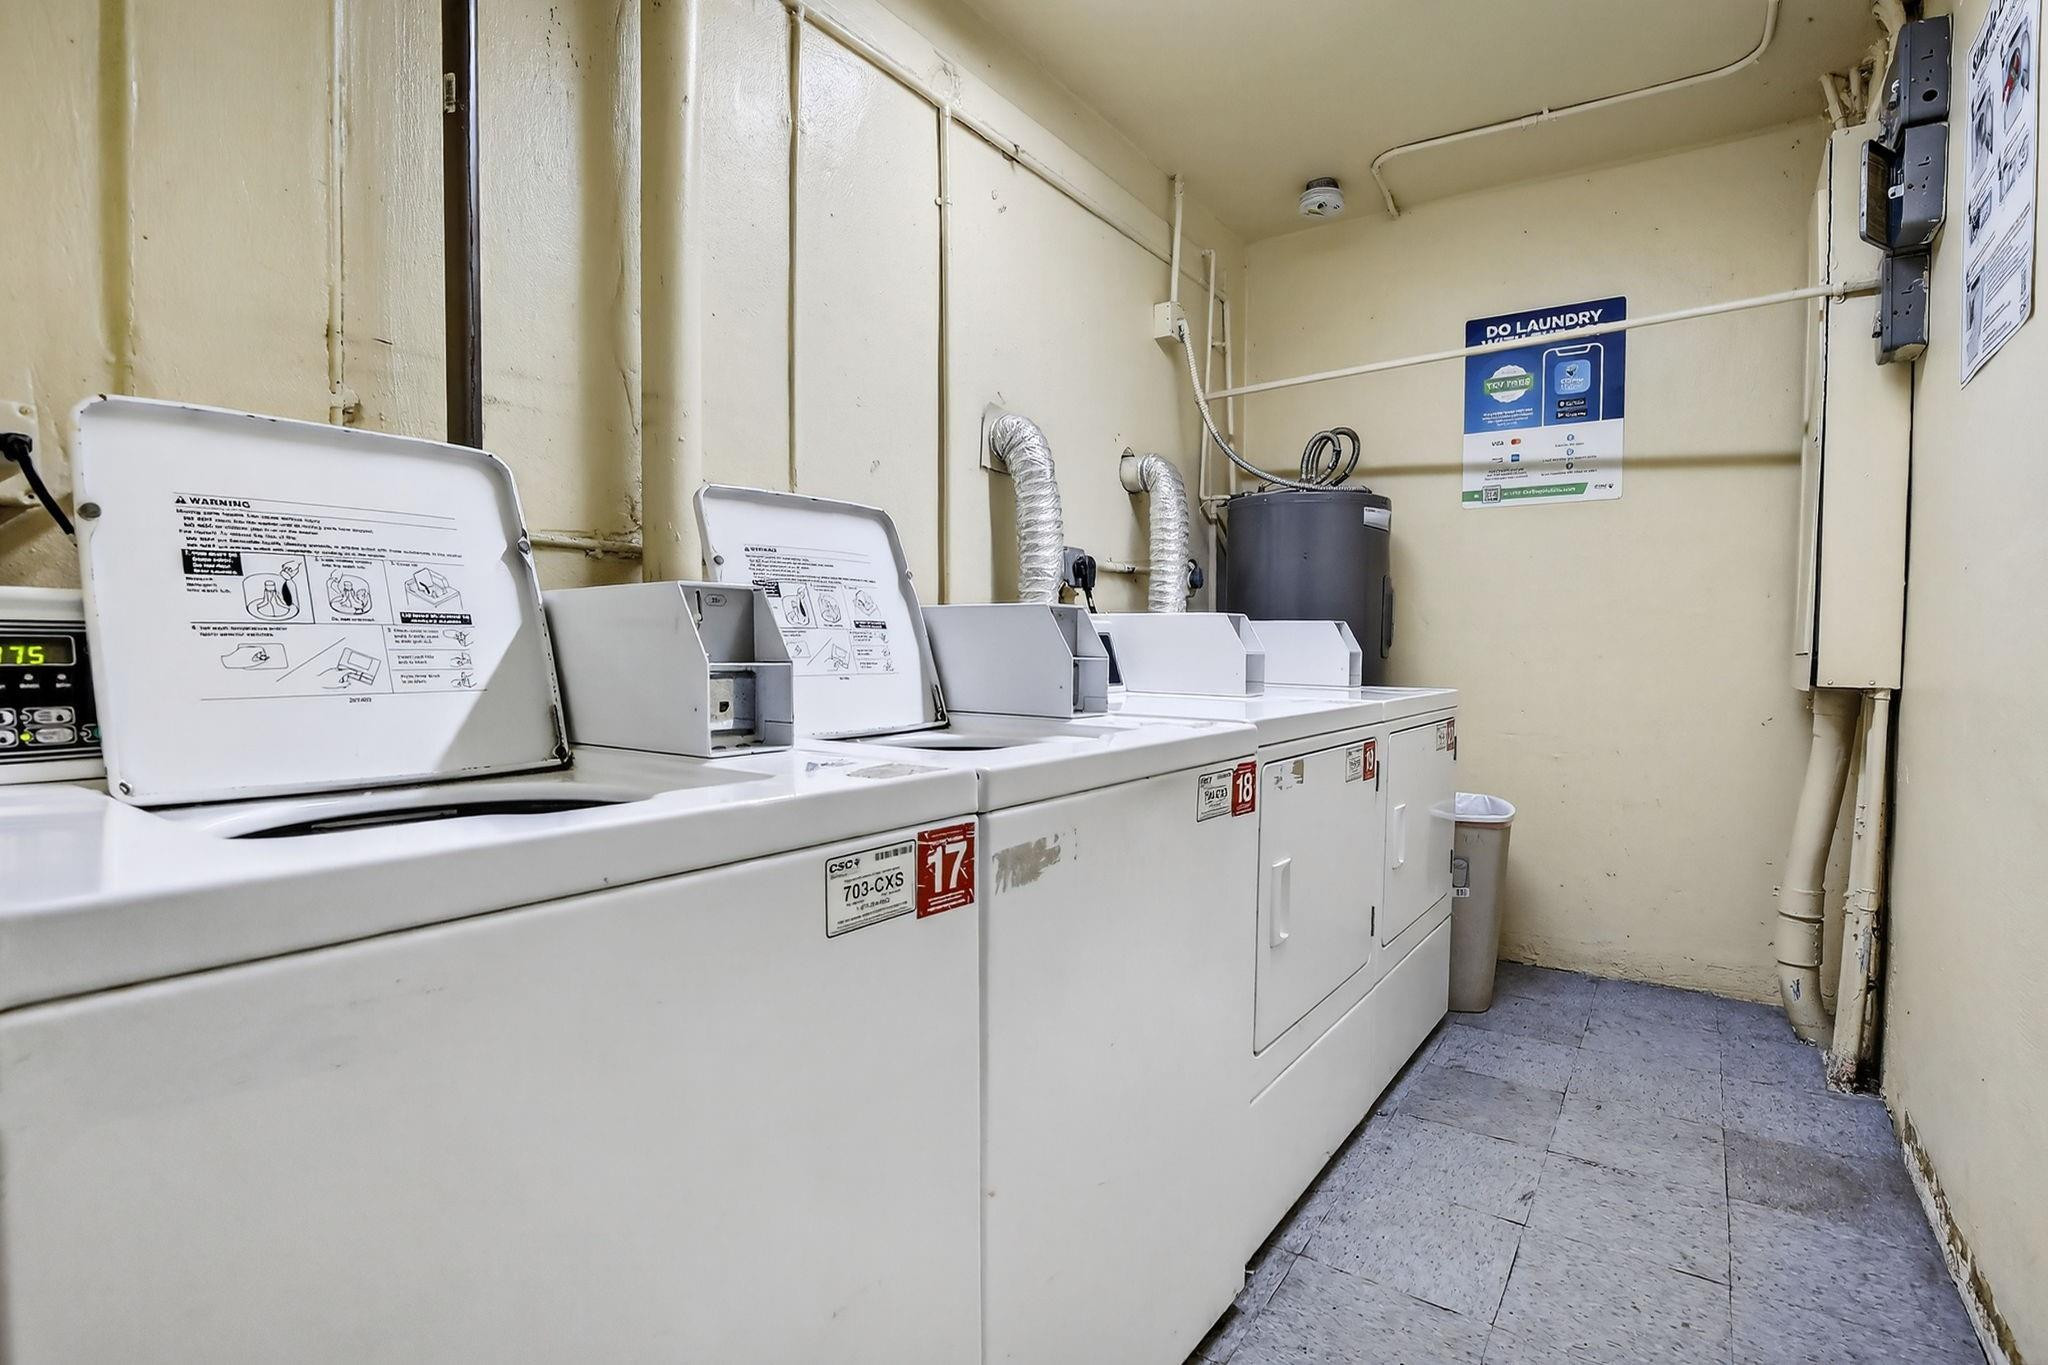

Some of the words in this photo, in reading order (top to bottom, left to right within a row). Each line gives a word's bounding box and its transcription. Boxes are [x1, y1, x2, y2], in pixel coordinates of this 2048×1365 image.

[1486, 323, 1511, 338] DO
[1516, 309, 1603, 334] LAUNDRY
[189, 496, 251, 509] WARNING
[1236, 772, 1253, 803] 18
[927, 840, 967, 893] 17
[843, 871, 904, 902] 703-CXS
